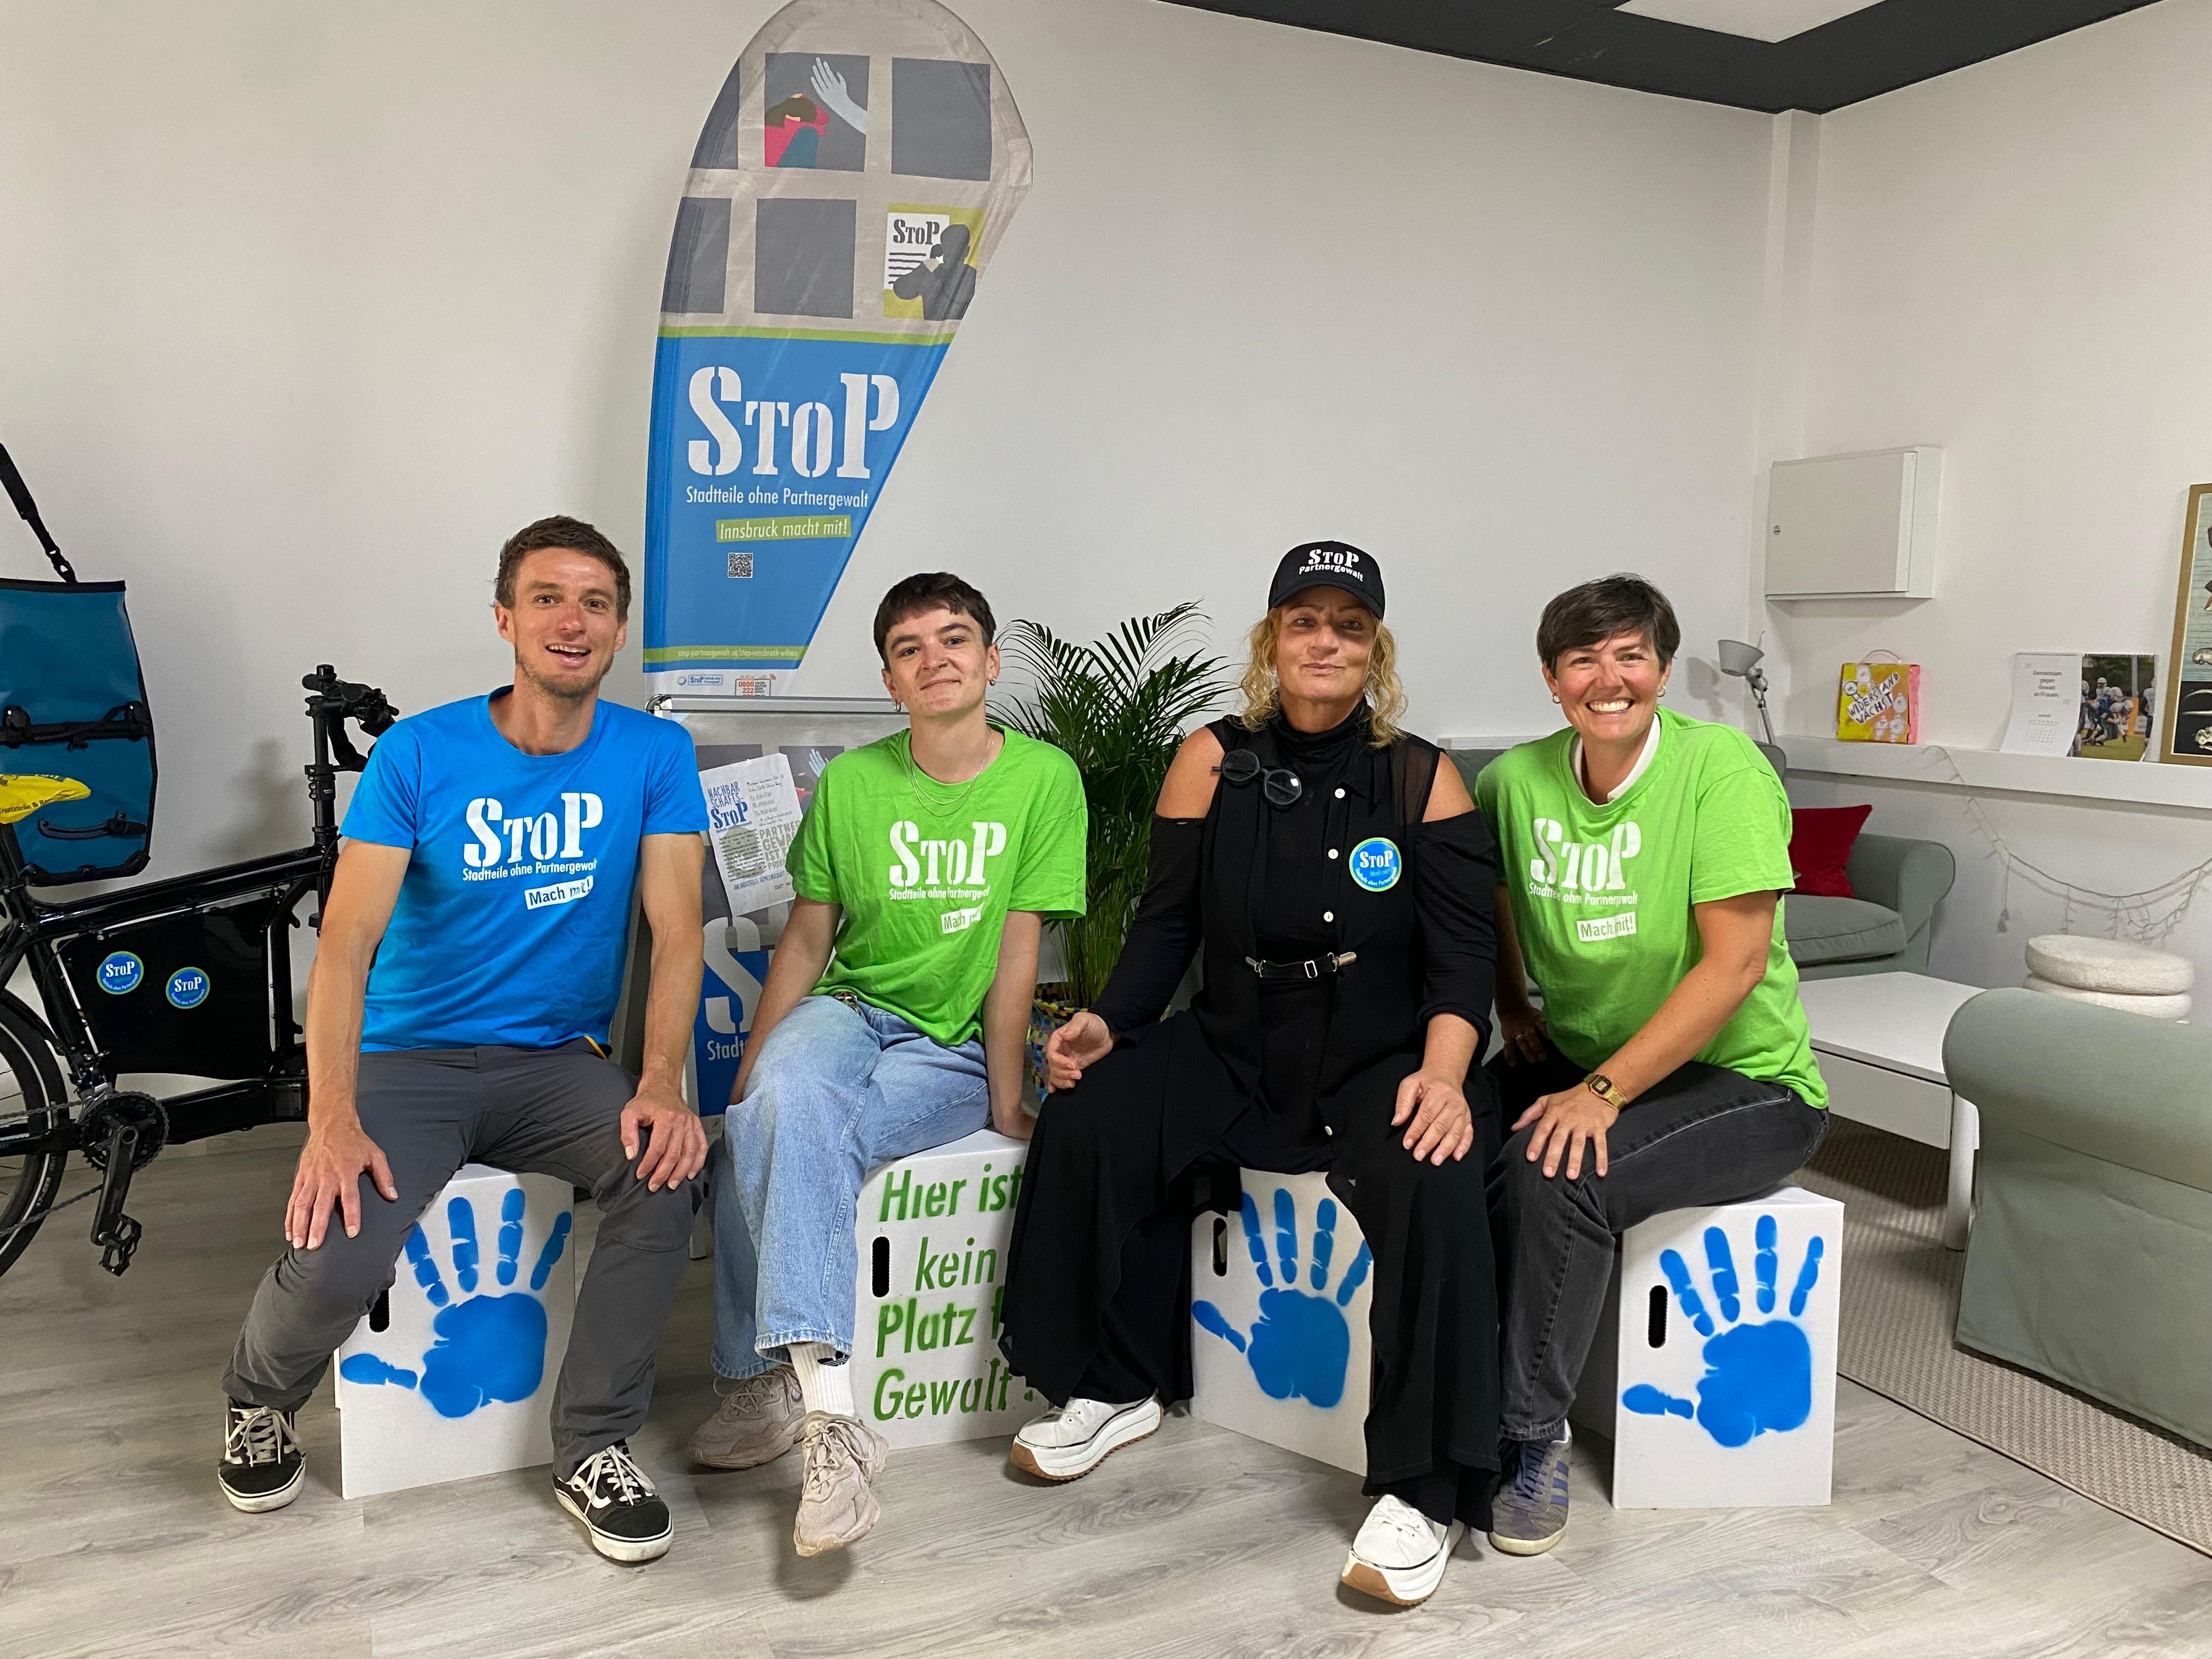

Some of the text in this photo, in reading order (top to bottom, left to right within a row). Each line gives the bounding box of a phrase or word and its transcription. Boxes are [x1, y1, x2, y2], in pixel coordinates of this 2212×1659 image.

[686, 485, 868, 510] Stadtteile ohne Partnergewalt
[720, 519, 847, 539] Innsbruck macht mit!
[1299, 564, 1363, 582] Partnergewalt
[1848, 674, 1899, 716] WIDERSTAND
[708, 781, 740, 799] NACHBAR
[762, 832, 795, 851] GEWA
[765, 849, 780, 861] IST
[462, 865, 508, 881] Stadtteile
[510, 863, 533, 877] ohne
[529, 879, 590, 905] Mach mit!
[889, 886, 926, 900] Stadtteile
[928, 886, 946, 899] ohne
[944, 913, 965, 930] Mach
[1581, 916, 1633, 938] Mach mit!
[879, 1164, 1024, 1222] Hier ist
[915, 1237, 997, 1291] kein
[876, 1297, 977, 1358] Platz
